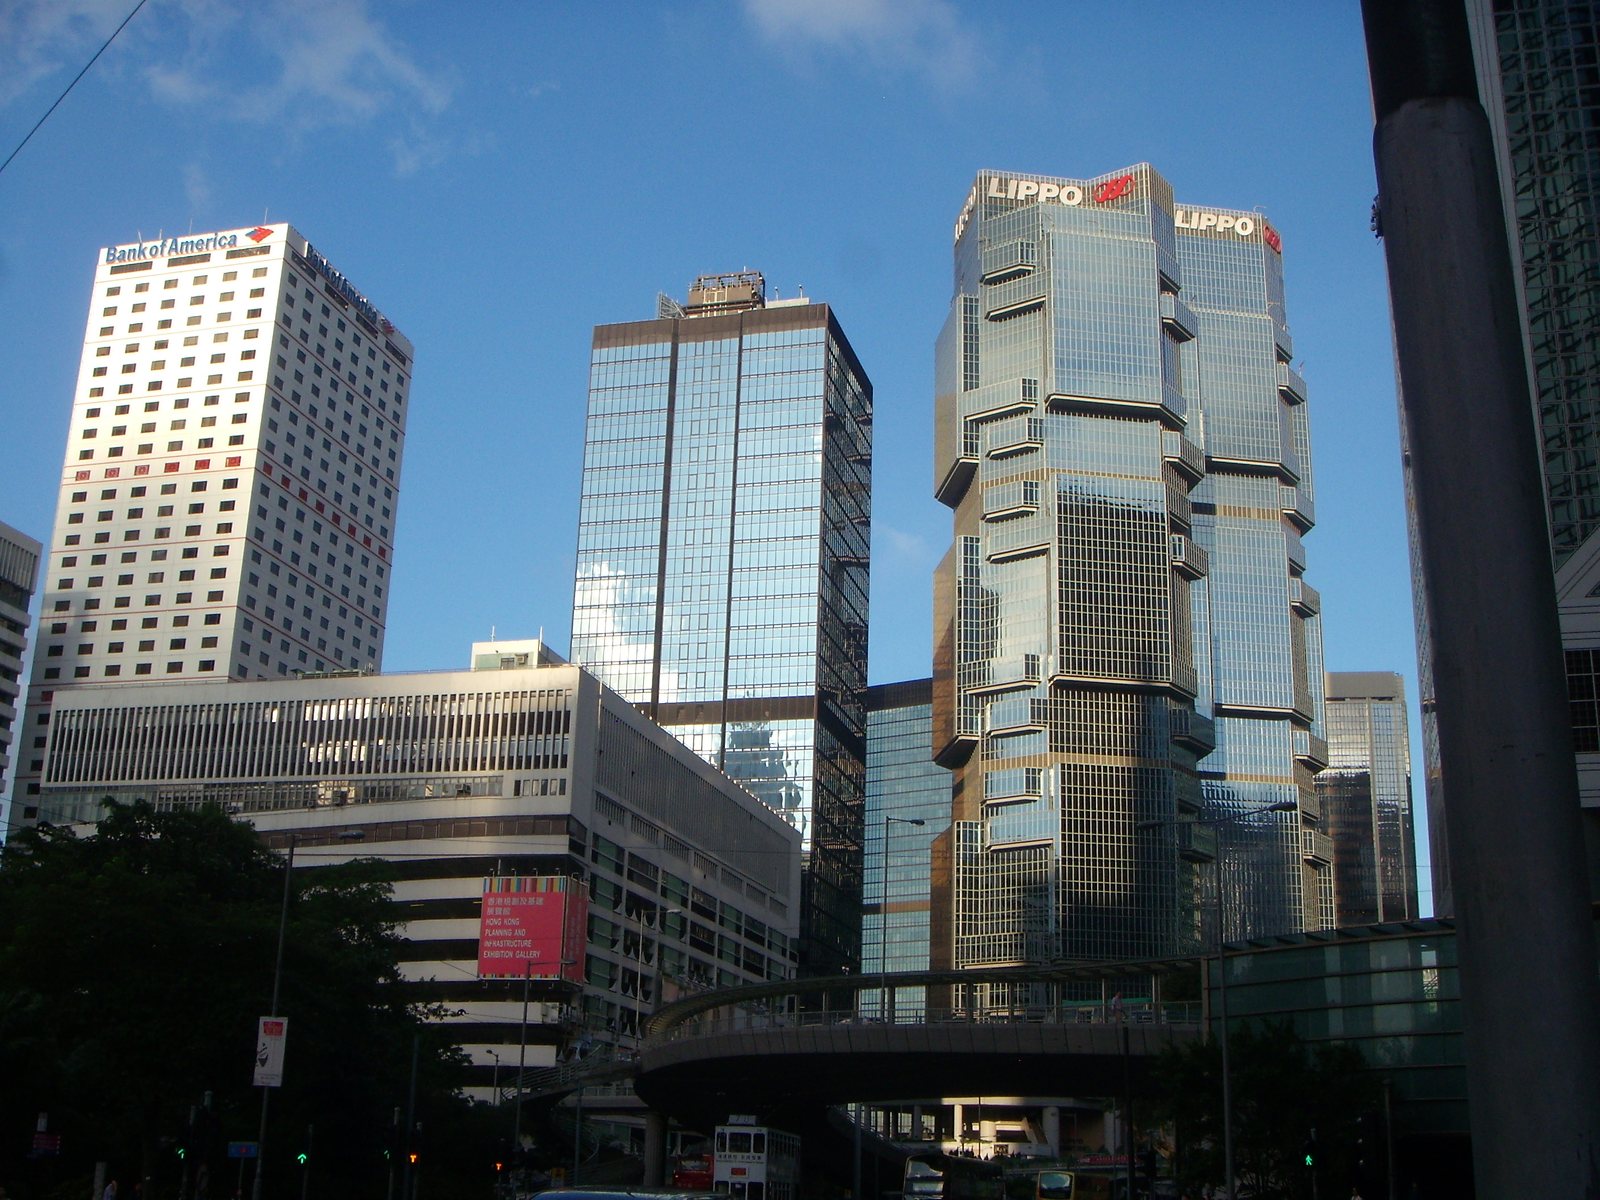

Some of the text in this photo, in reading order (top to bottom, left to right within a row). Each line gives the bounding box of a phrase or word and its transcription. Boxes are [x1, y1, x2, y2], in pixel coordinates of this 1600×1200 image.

[989, 177, 1082, 206] LIPPO
[1175, 210, 1254, 236] LIPPO
[106, 233, 238, 263] Bank of America
